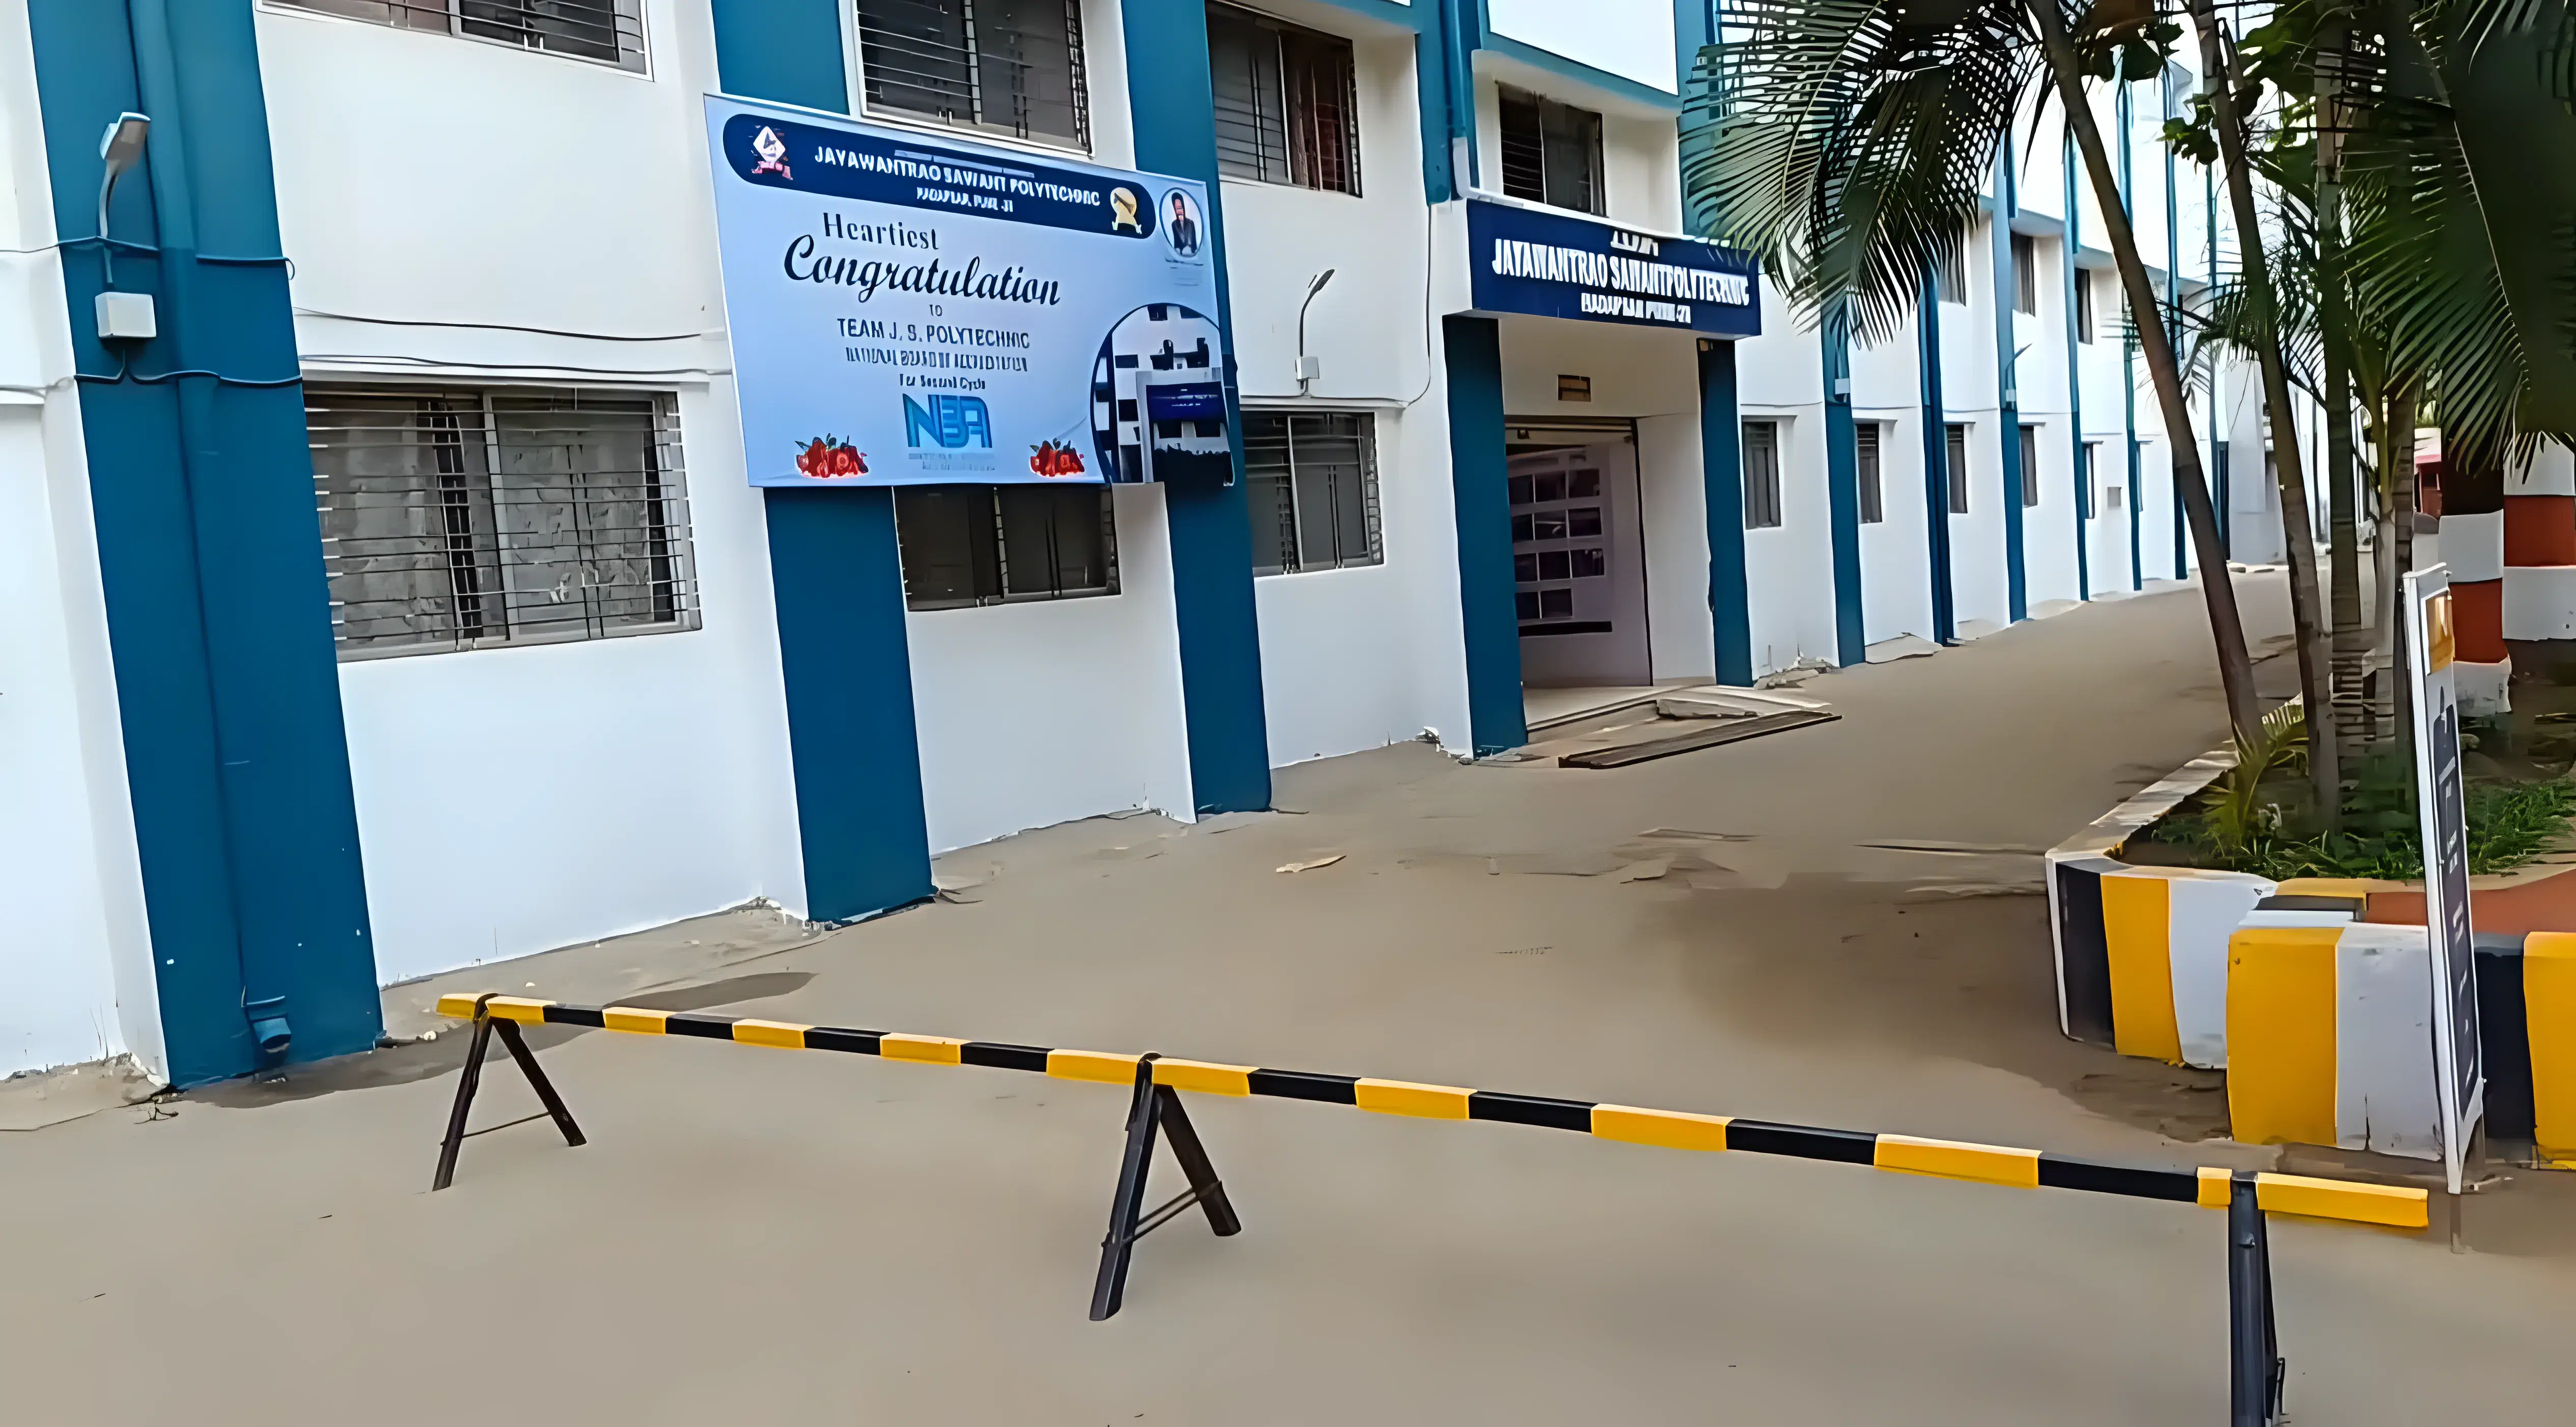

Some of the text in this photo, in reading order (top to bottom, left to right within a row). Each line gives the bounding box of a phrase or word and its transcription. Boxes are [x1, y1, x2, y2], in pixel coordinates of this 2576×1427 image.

[823, 212, 939, 250] Heartiest
[783, 234, 1060, 305] Congratulation
[837, 318, 885, 338] TEAM
